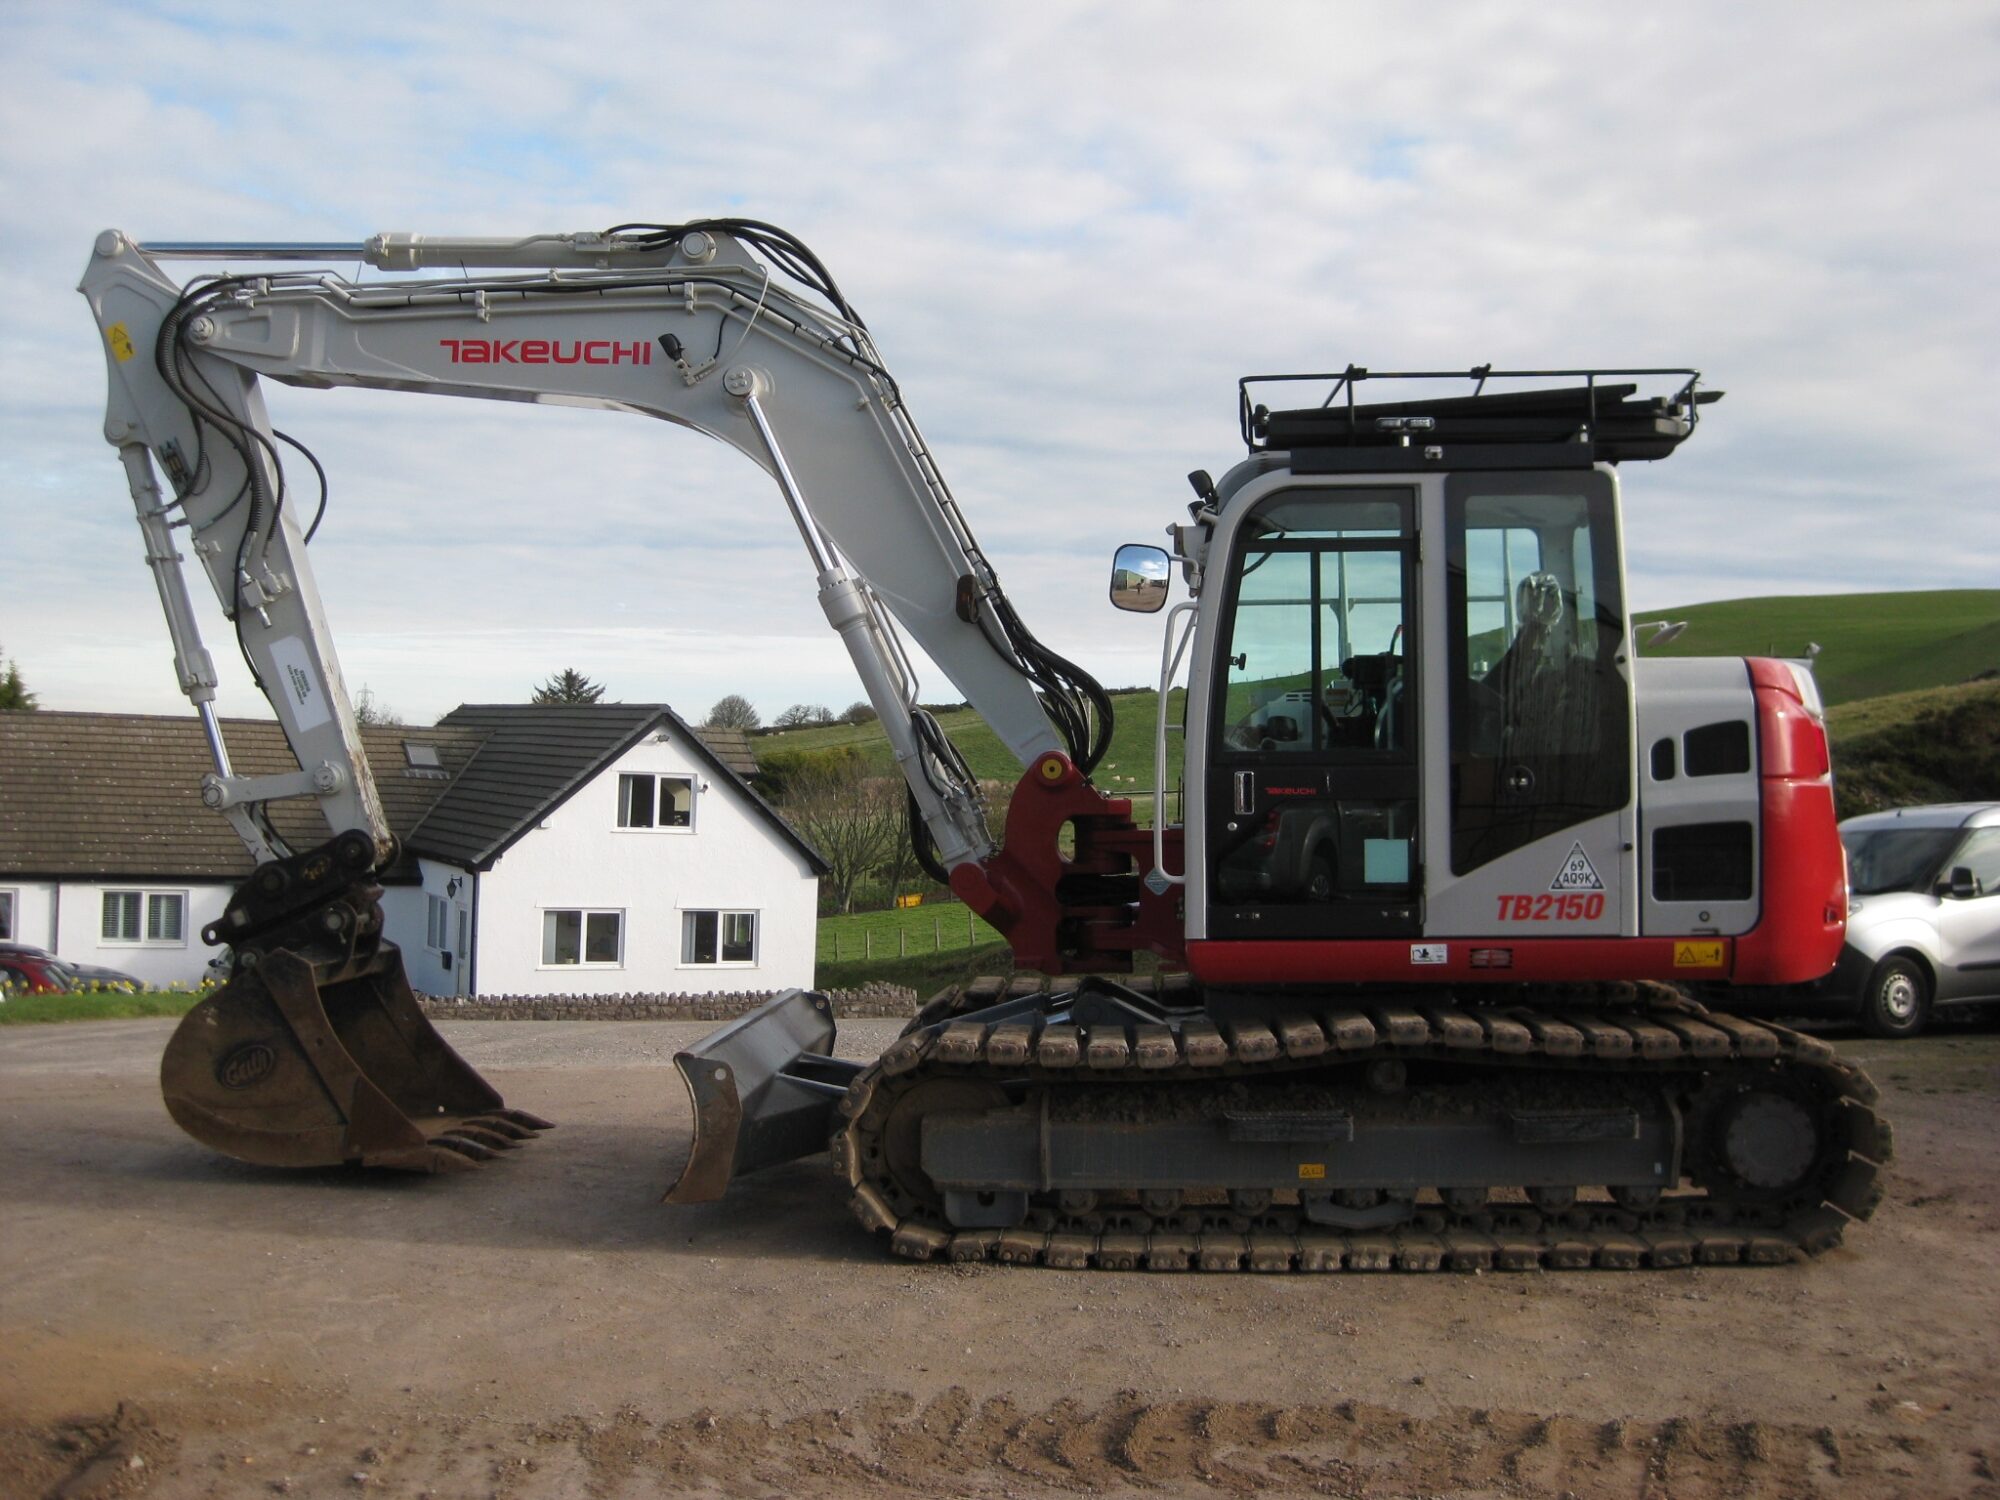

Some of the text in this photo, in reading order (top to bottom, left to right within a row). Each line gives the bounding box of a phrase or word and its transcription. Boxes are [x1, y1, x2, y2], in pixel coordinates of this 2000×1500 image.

[440, 340, 651, 365] TAKEUCHI
[1570, 860, 1585, 872] 69
[1562, 872, 1592, 884] AQ9K
[1498, 893, 1605, 920] TB2150
